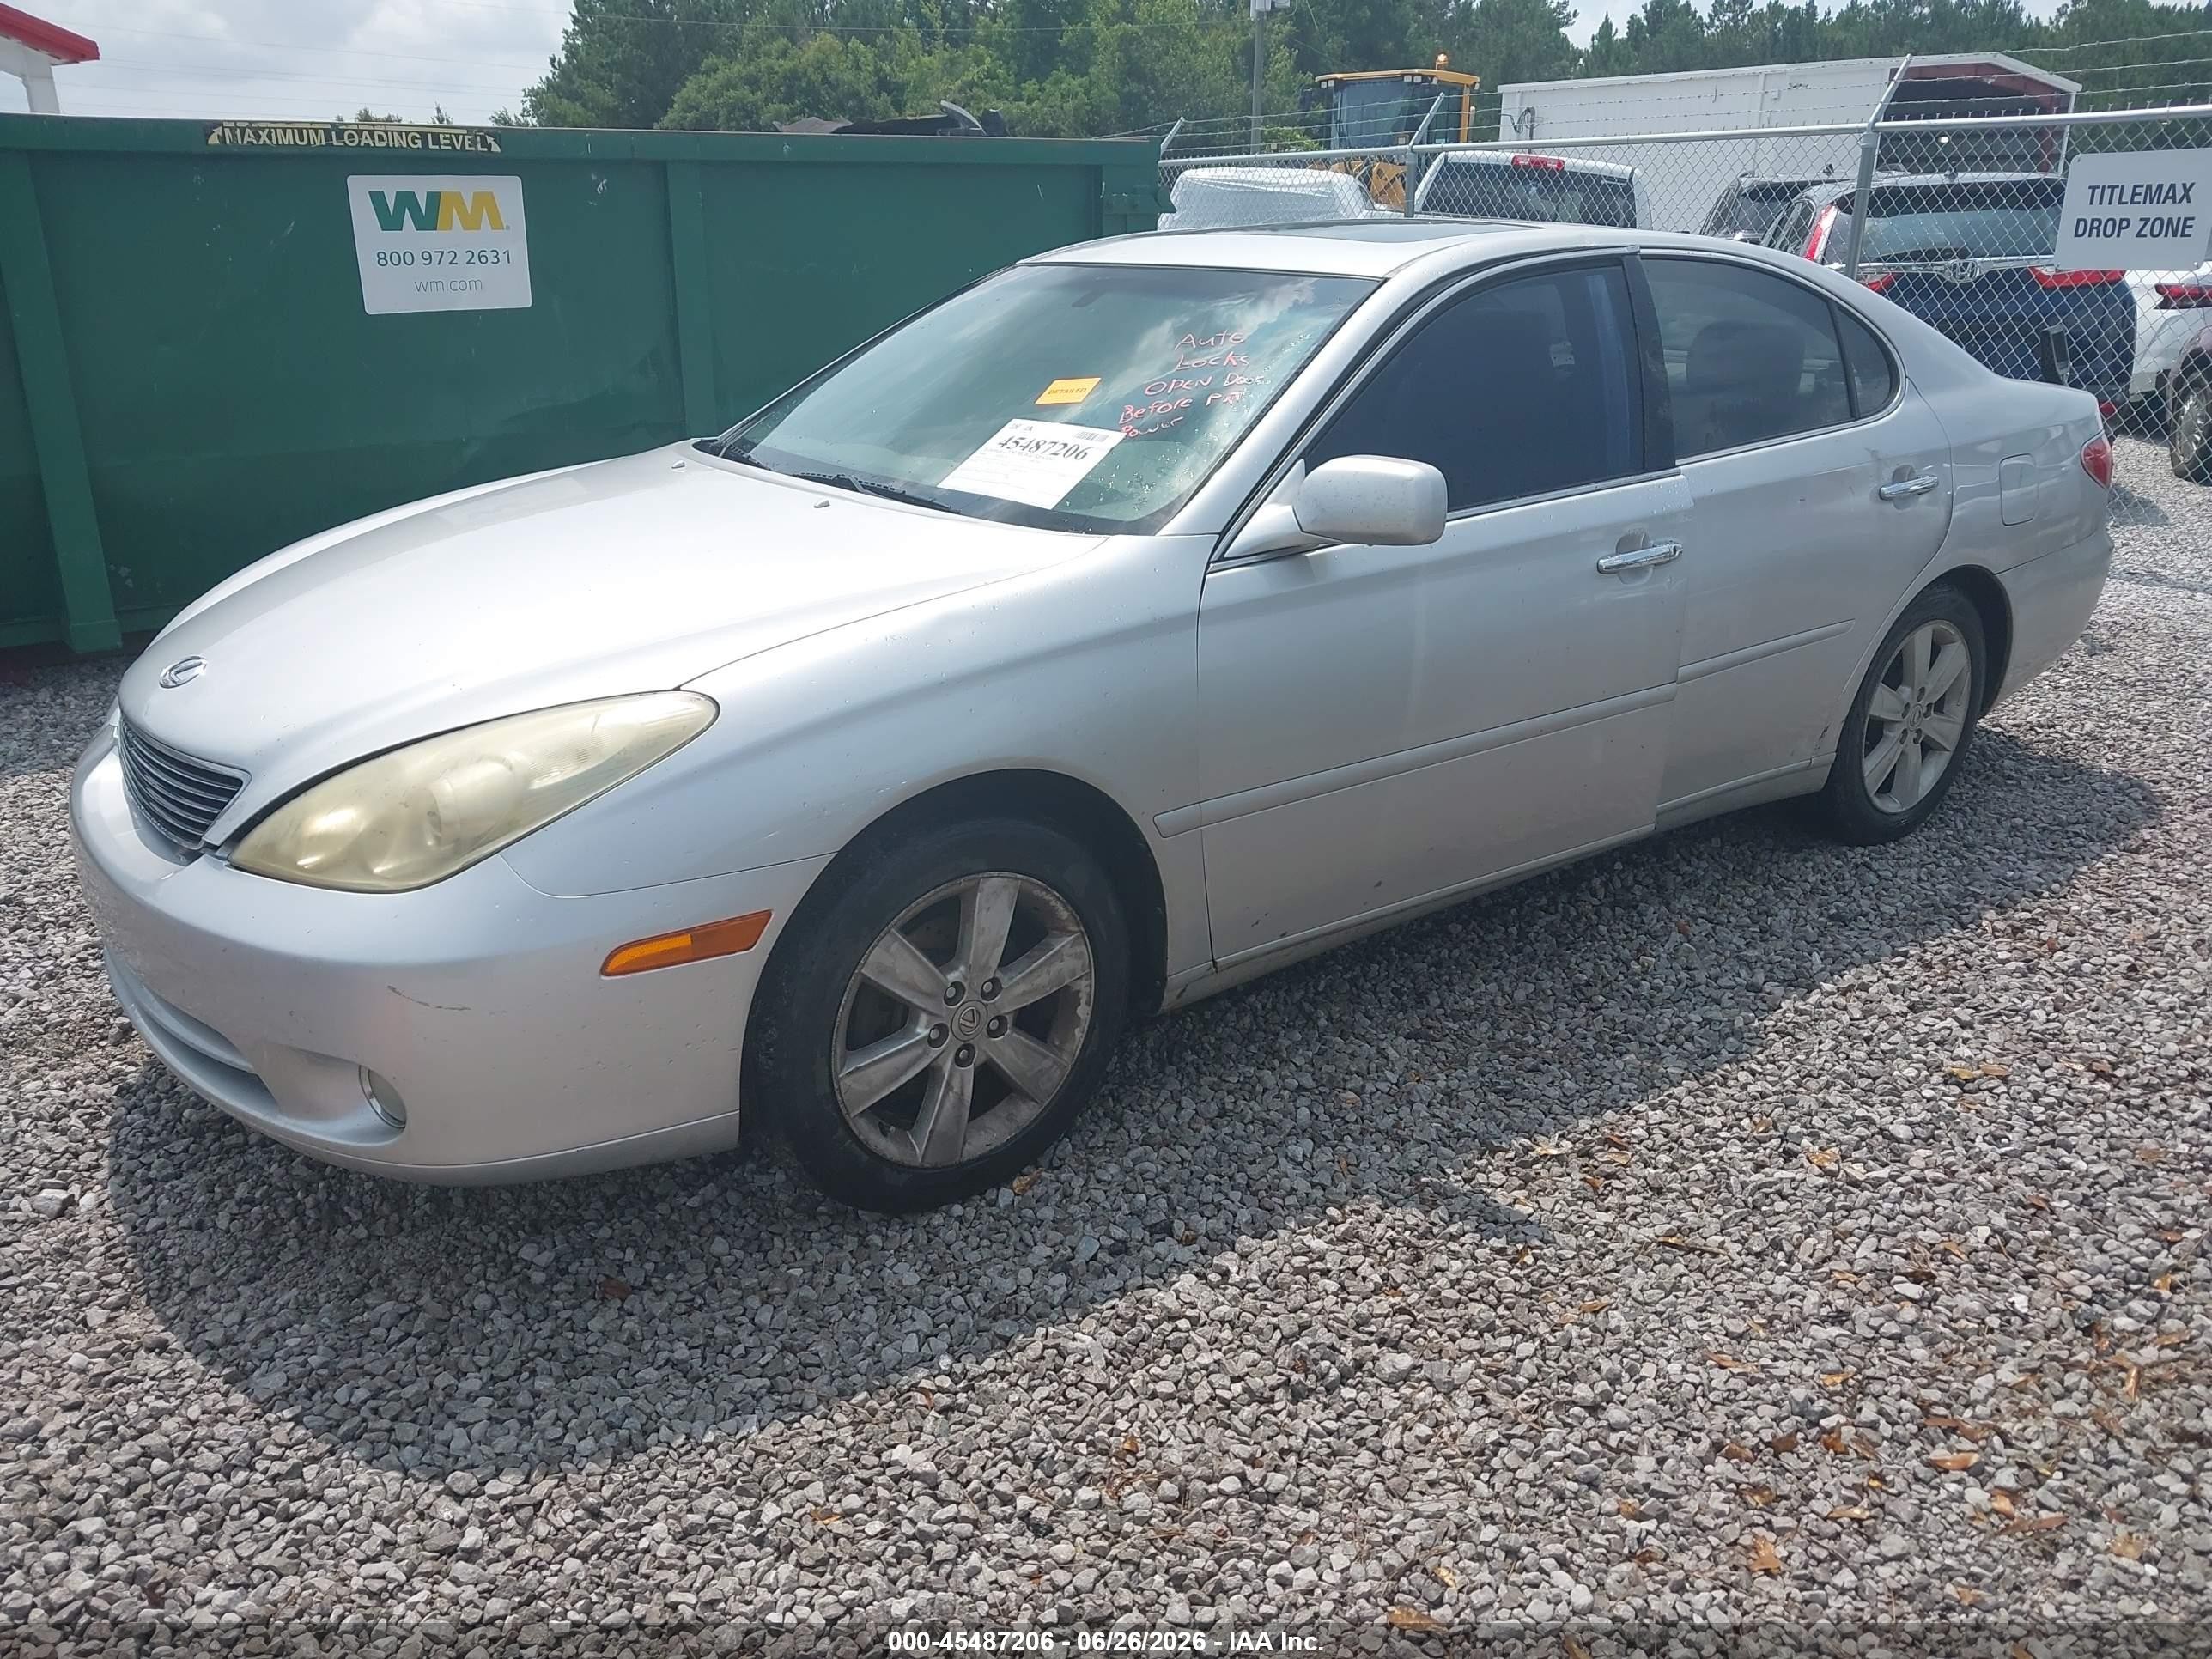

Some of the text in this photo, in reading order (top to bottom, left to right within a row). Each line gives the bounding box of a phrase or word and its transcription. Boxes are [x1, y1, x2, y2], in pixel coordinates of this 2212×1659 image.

[224, 128, 488, 152] MAXIMUM LOADING LEVEL
[2087, 182, 2196, 205] TITLEMAX
[368, 191, 505, 231] WM
[2074, 216, 2196, 238] DROP ZONE
[376, 249, 511, 267] 800 972 2631
[414, 279, 483, 293] wm.com
[998, 435, 1096, 461] 45487206
